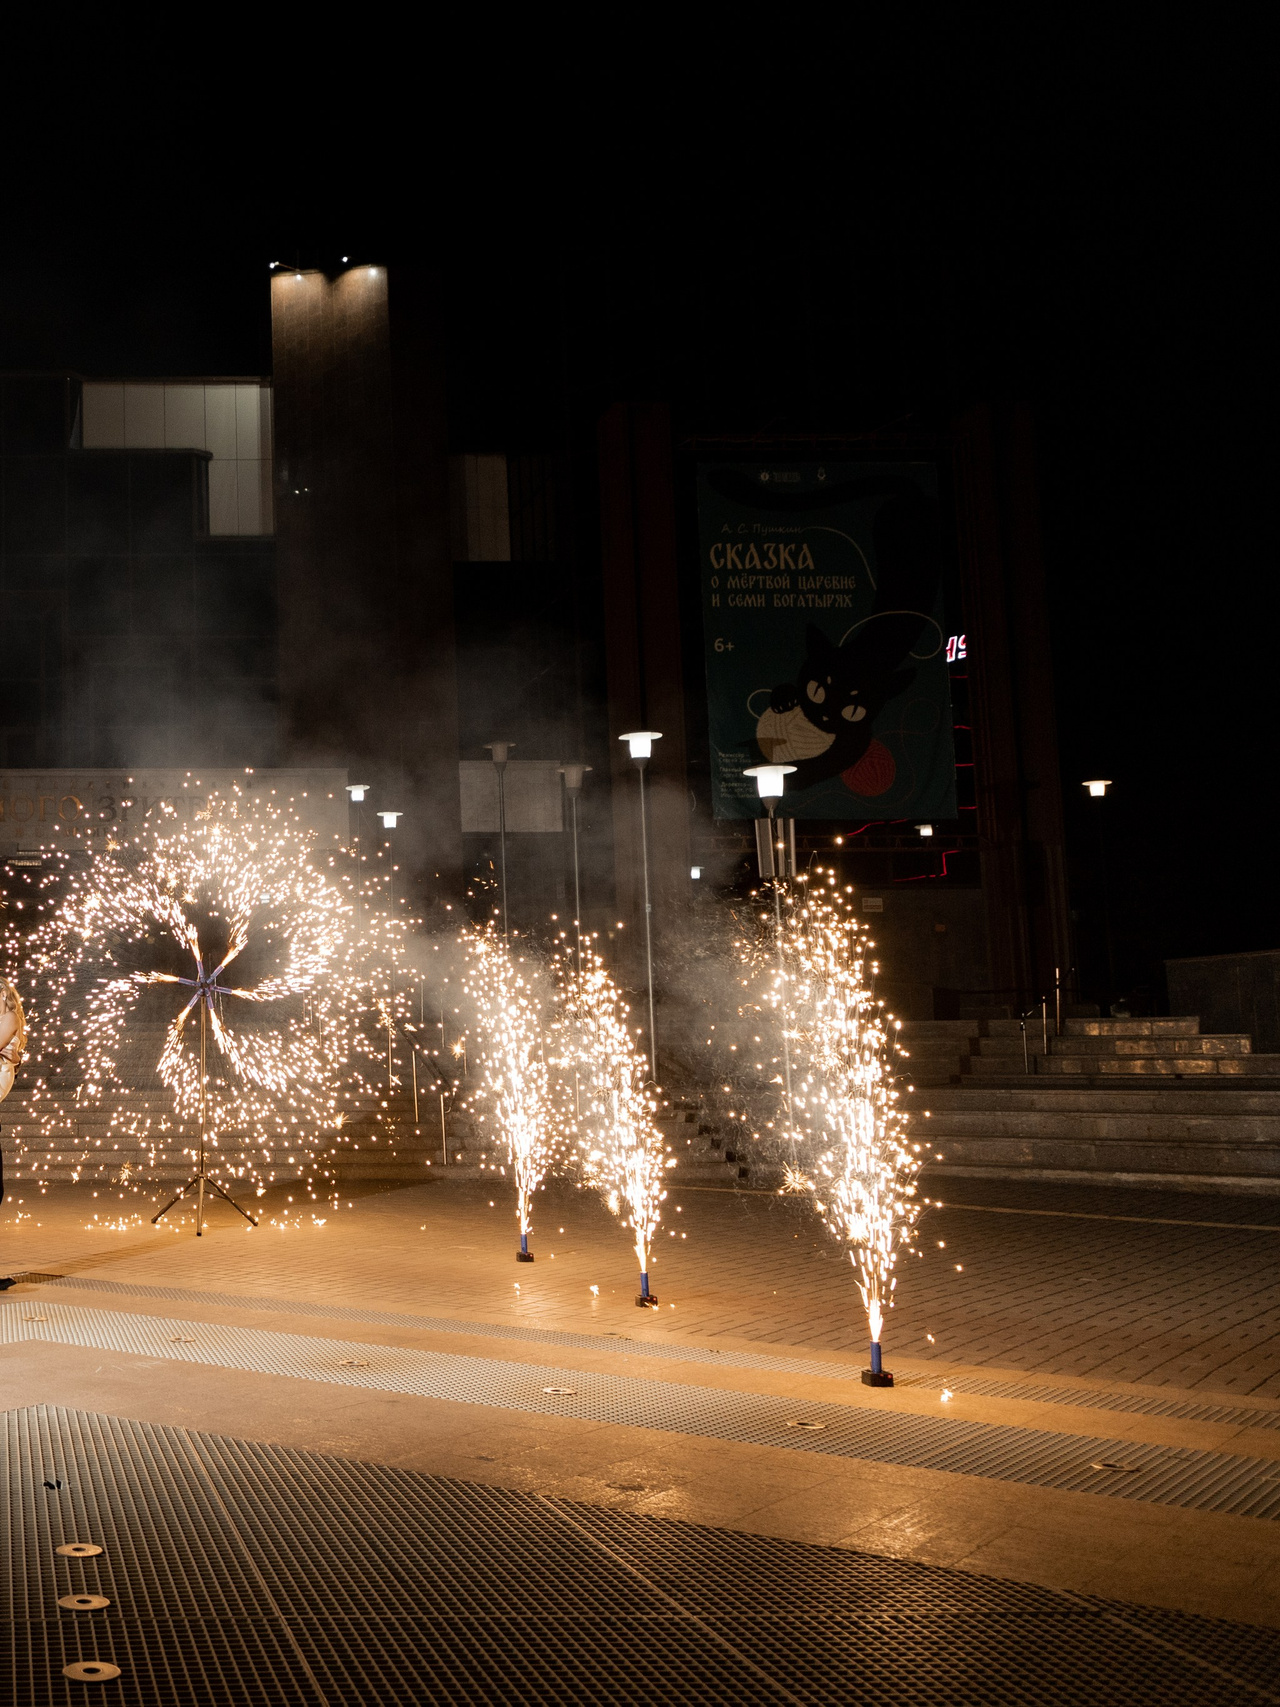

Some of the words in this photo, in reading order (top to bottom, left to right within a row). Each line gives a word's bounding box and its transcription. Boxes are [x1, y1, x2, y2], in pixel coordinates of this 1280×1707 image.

[753, 523, 803, 537] Пушкин
[709, 542, 816, 570] СКАЗКА
[711, 575, 719, 589] О
[727, 573, 791, 589] МЁРТВОЙ
[797, 575, 857, 592] ЦАРЕВНЕ
[711, 594, 720, 608] И
[728, 593, 766, 608] СЕМИ
[773, 593, 853, 608] БОГАТЫРЯХ
[713, 638, 735, 653] 6+
